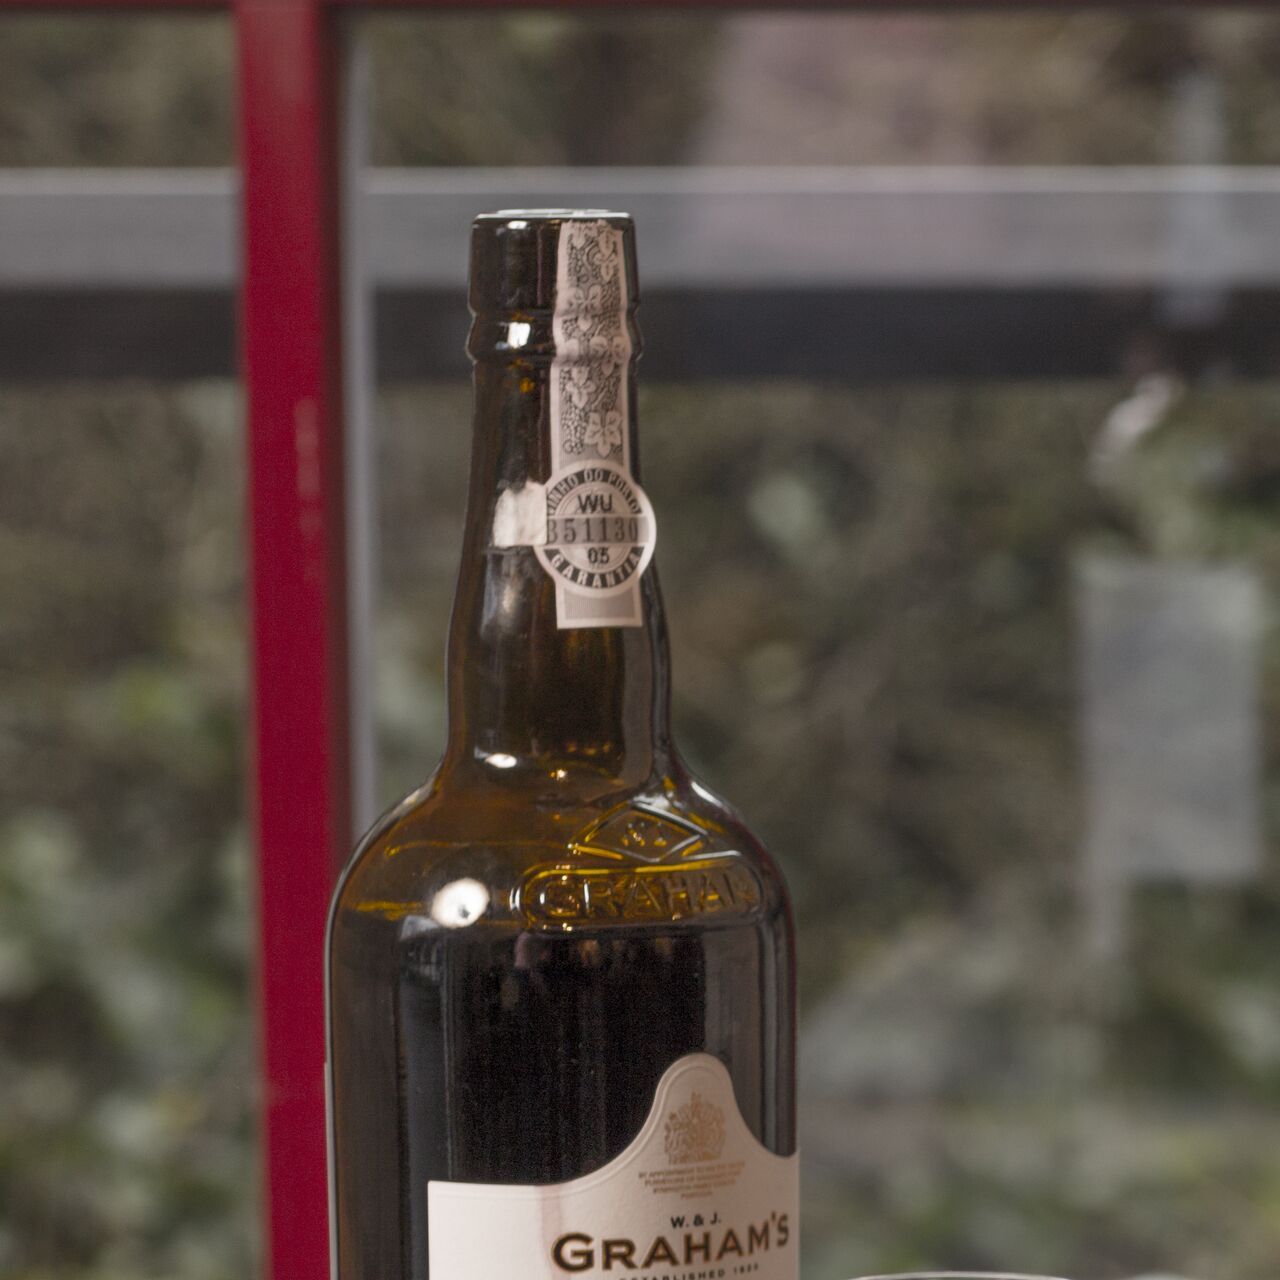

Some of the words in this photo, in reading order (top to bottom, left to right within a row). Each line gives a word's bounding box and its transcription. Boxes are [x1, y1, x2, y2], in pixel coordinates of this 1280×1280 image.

[577, 493, 612, 514] WU
[670, 1216, 690, 1229] W.
[710, 1212, 722, 1224] J.
[552, 1211, 790, 1273] GRAHAM'S
